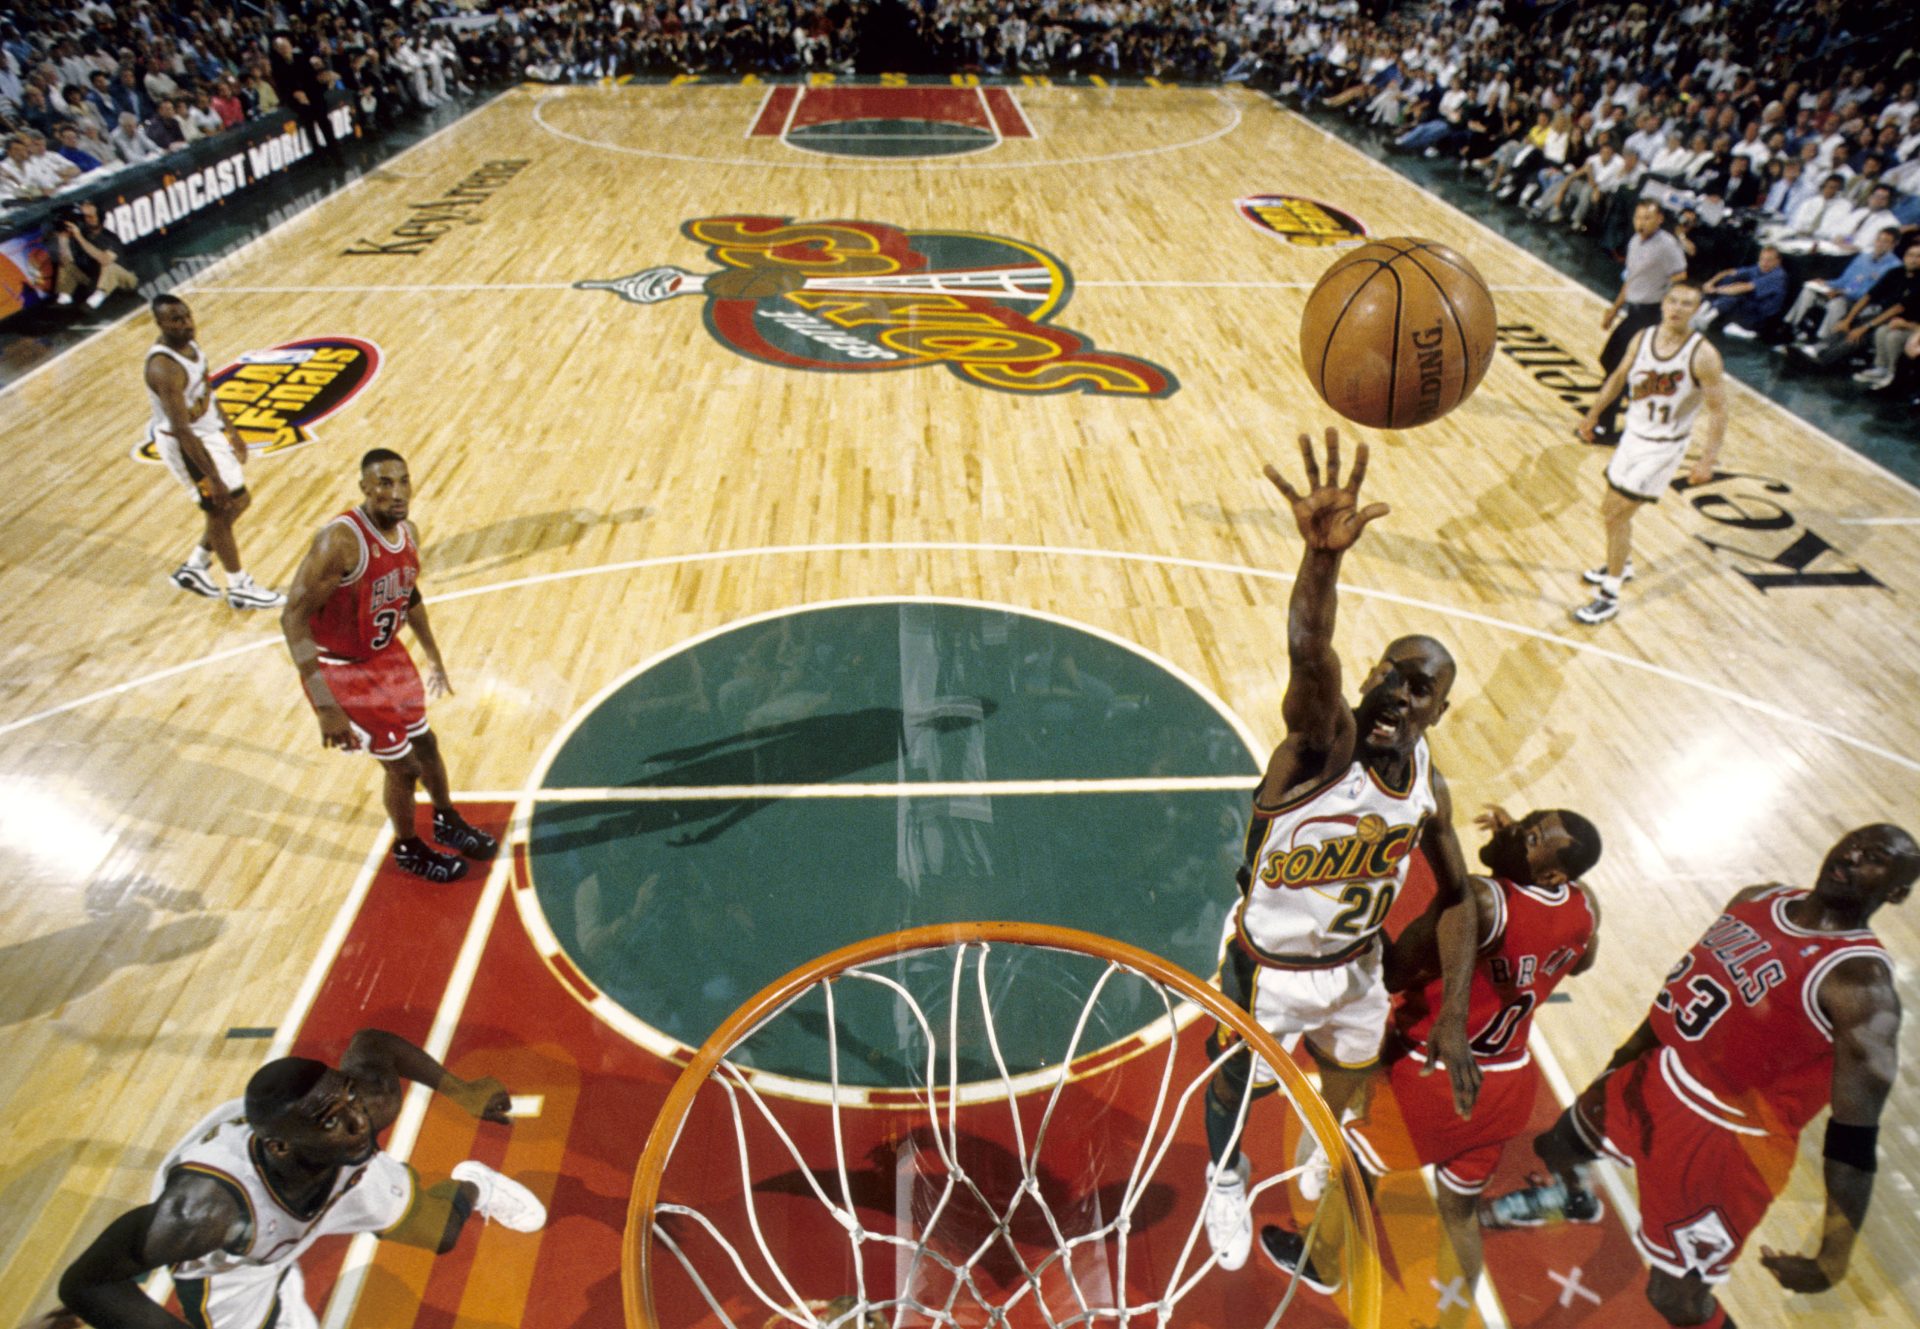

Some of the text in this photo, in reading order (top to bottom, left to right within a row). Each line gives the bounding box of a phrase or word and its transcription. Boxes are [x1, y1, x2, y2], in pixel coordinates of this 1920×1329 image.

[757, 309, 899, 360] SEATTLE
[233, 347, 361, 429] Finals
[1647, 401, 1672, 425] 11
[1327, 882, 1395, 936] 20
[1469, 990, 1536, 1057] 0
